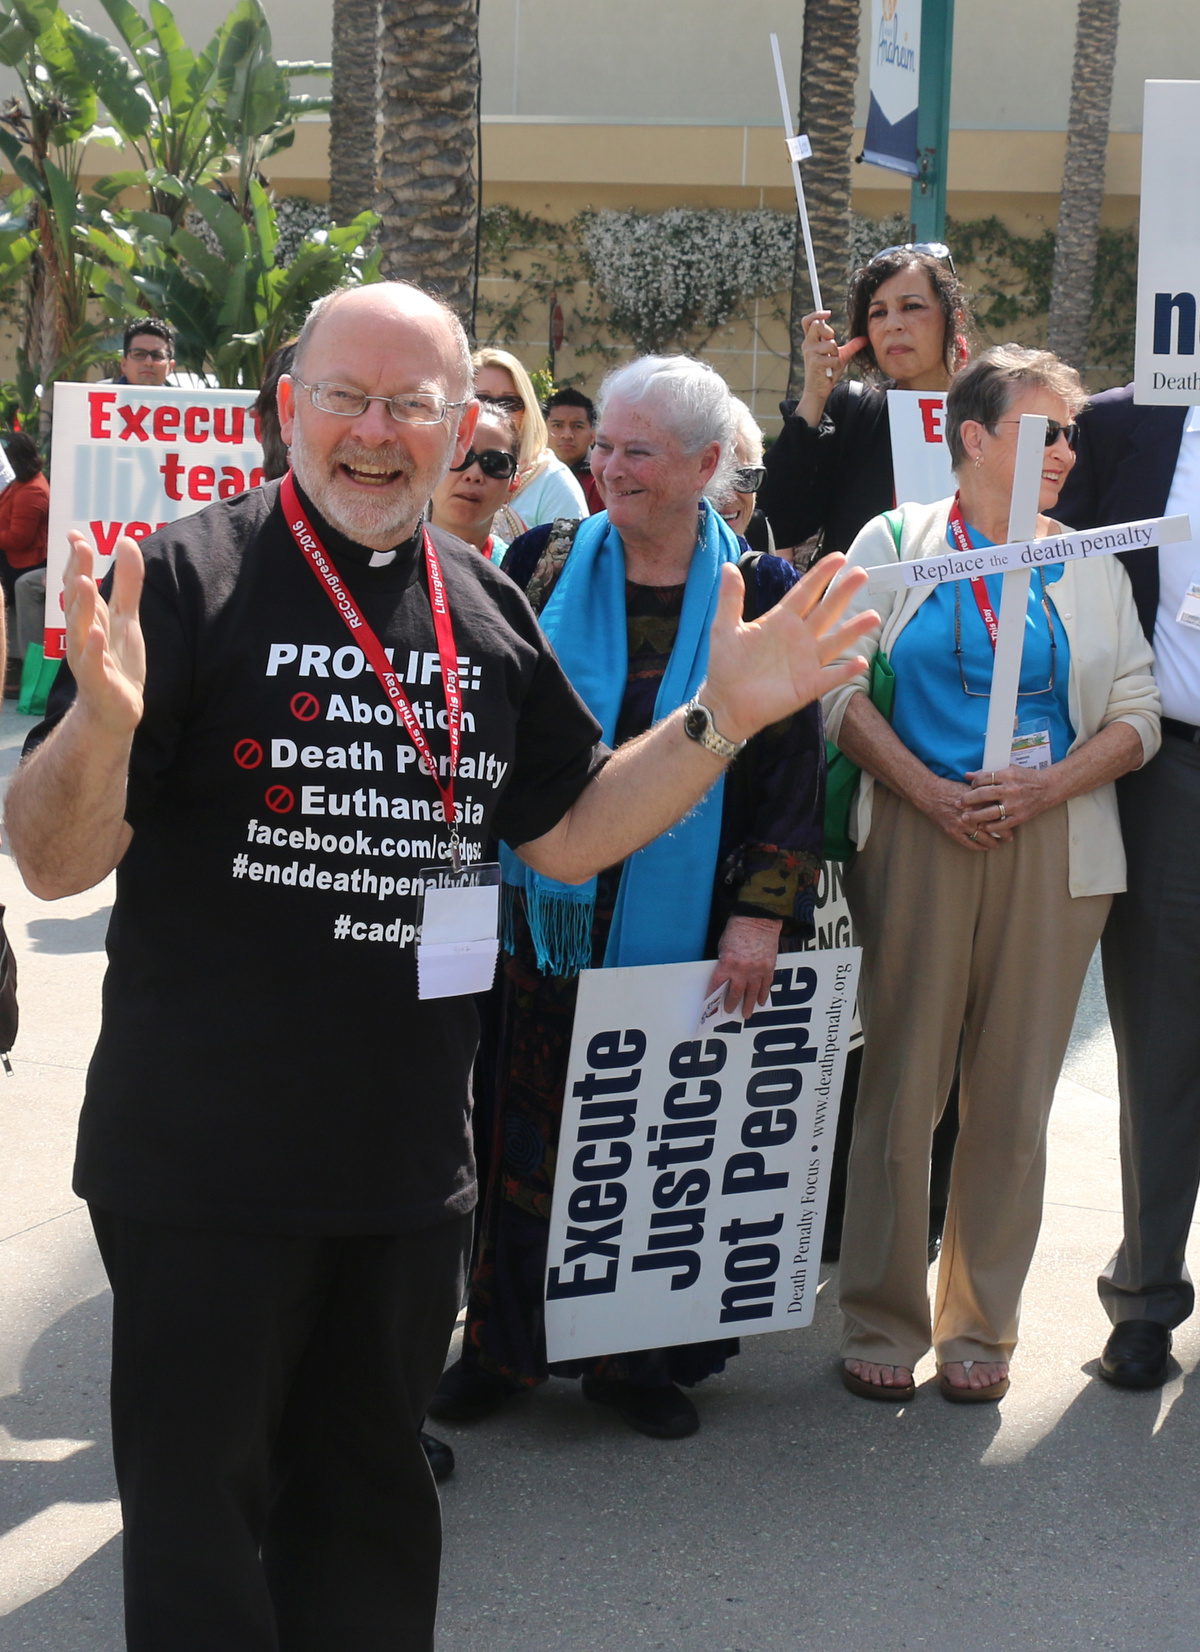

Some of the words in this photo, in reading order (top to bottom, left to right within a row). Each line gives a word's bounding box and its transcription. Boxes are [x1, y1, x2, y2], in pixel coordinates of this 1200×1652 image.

[292, 520, 318, 552] 2016
[912, 554, 985, 583] Replace
[990, 554, 1009, 568] the
[1020, 537, 1075, 564] death
[1081, 525, 1153, 558] penalty
[311, 551, 363, 629] RECongress
[429, 559, 446, 615] Liturgical
[982, 608, 994, 623] Day
[382, 672, 400, 698] Day
[446, 668, 458, 694] Day
[397, 699, 416, 729] This
[449, 696, 460, 724] This
[271, 738, 384, 772] Death
[396, 744, 508, 789] Penalty
[301, 785, 485, 825] Euthanasia
[247, 819, 482, 867] facebook.com/cdpsc
[812, 962, 853, 1139] www.deathpenalty.org
[721, 966, 818, 1196] People
[546, 1028, 647, 1301] Execute
[631, 1020, 742, 1291] Justice,
[800, 1158, 821, 1205] Focus
[793, 1208, 818, 1265] Penalty
[719, 1212, 785, 1324] not
[787, 1269, 807, 1314] Death
